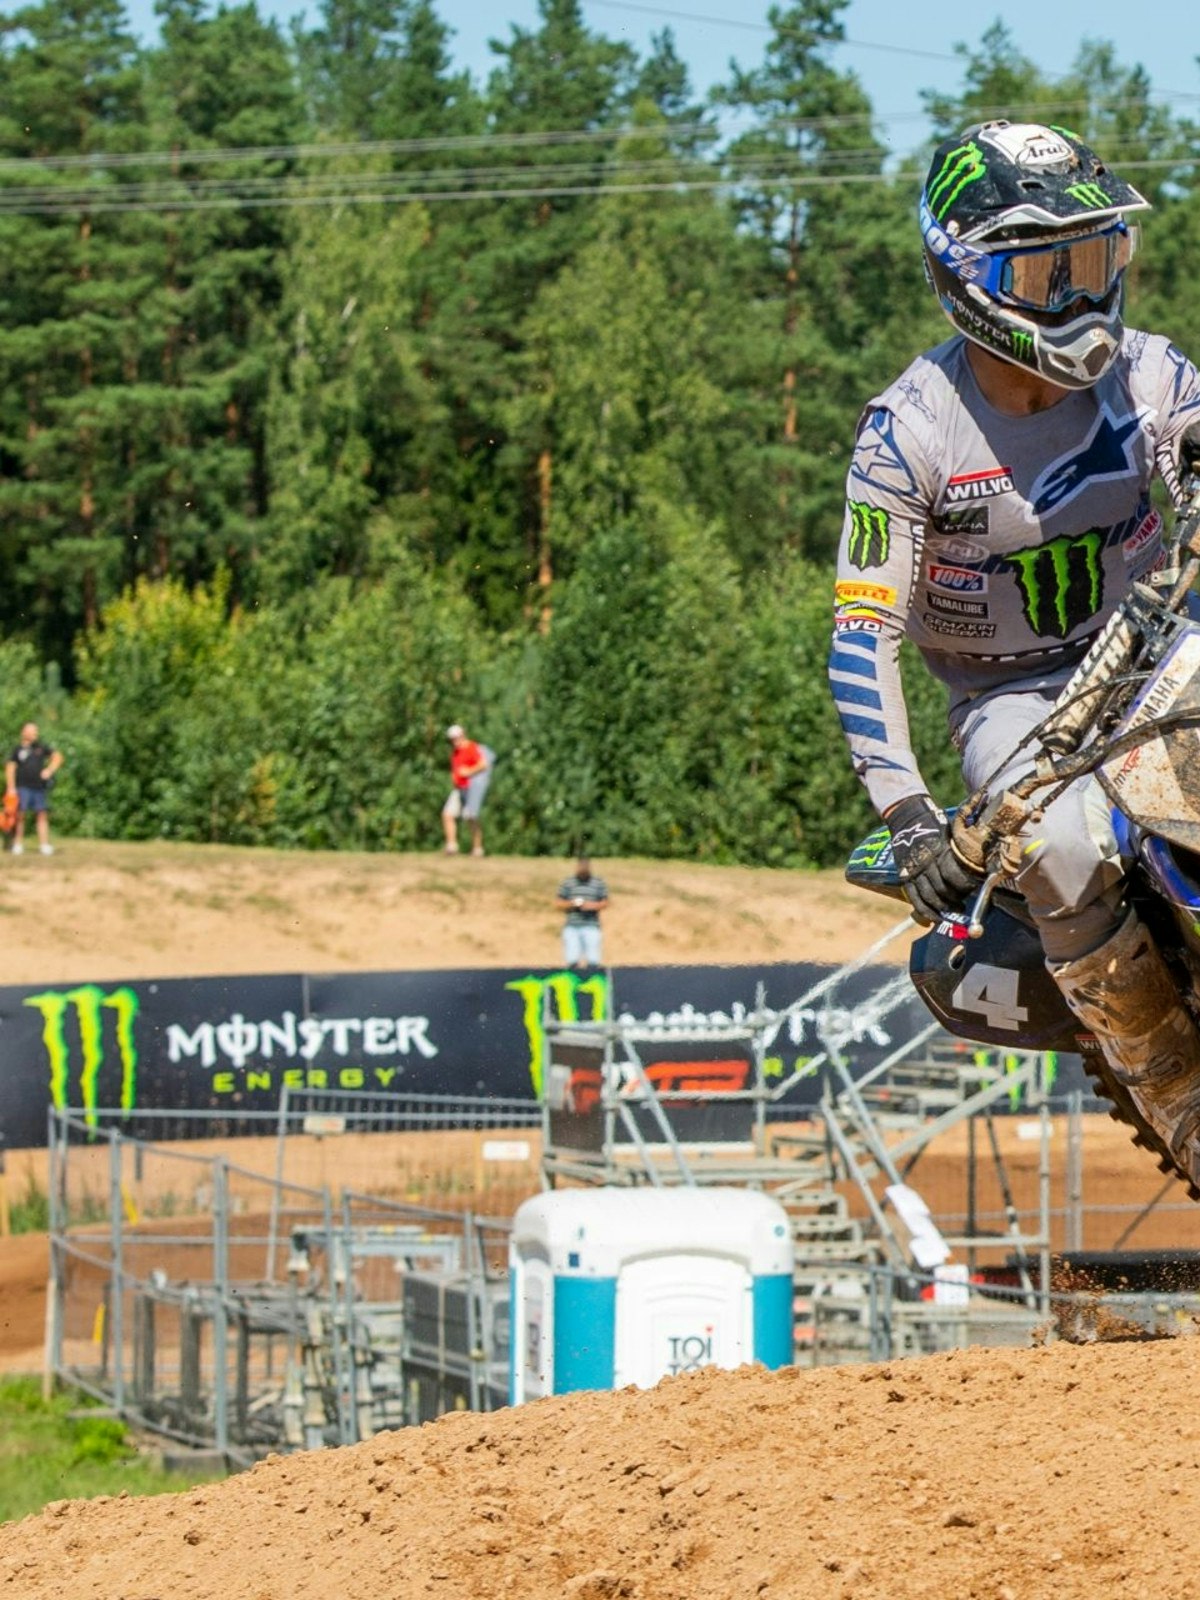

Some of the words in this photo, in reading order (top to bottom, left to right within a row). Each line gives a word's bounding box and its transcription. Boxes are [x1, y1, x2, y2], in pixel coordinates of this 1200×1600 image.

[946, 476, 1014, 501] WILVO
[933, 568, 980, 591] 100%
[930, 594, 986, 615] YAMALUBE
[952, 962, 1029, 1032] 4
[166, 1011, 439, 1069] MONSTER
[212, 1066, 397, 1093] ENERGY
